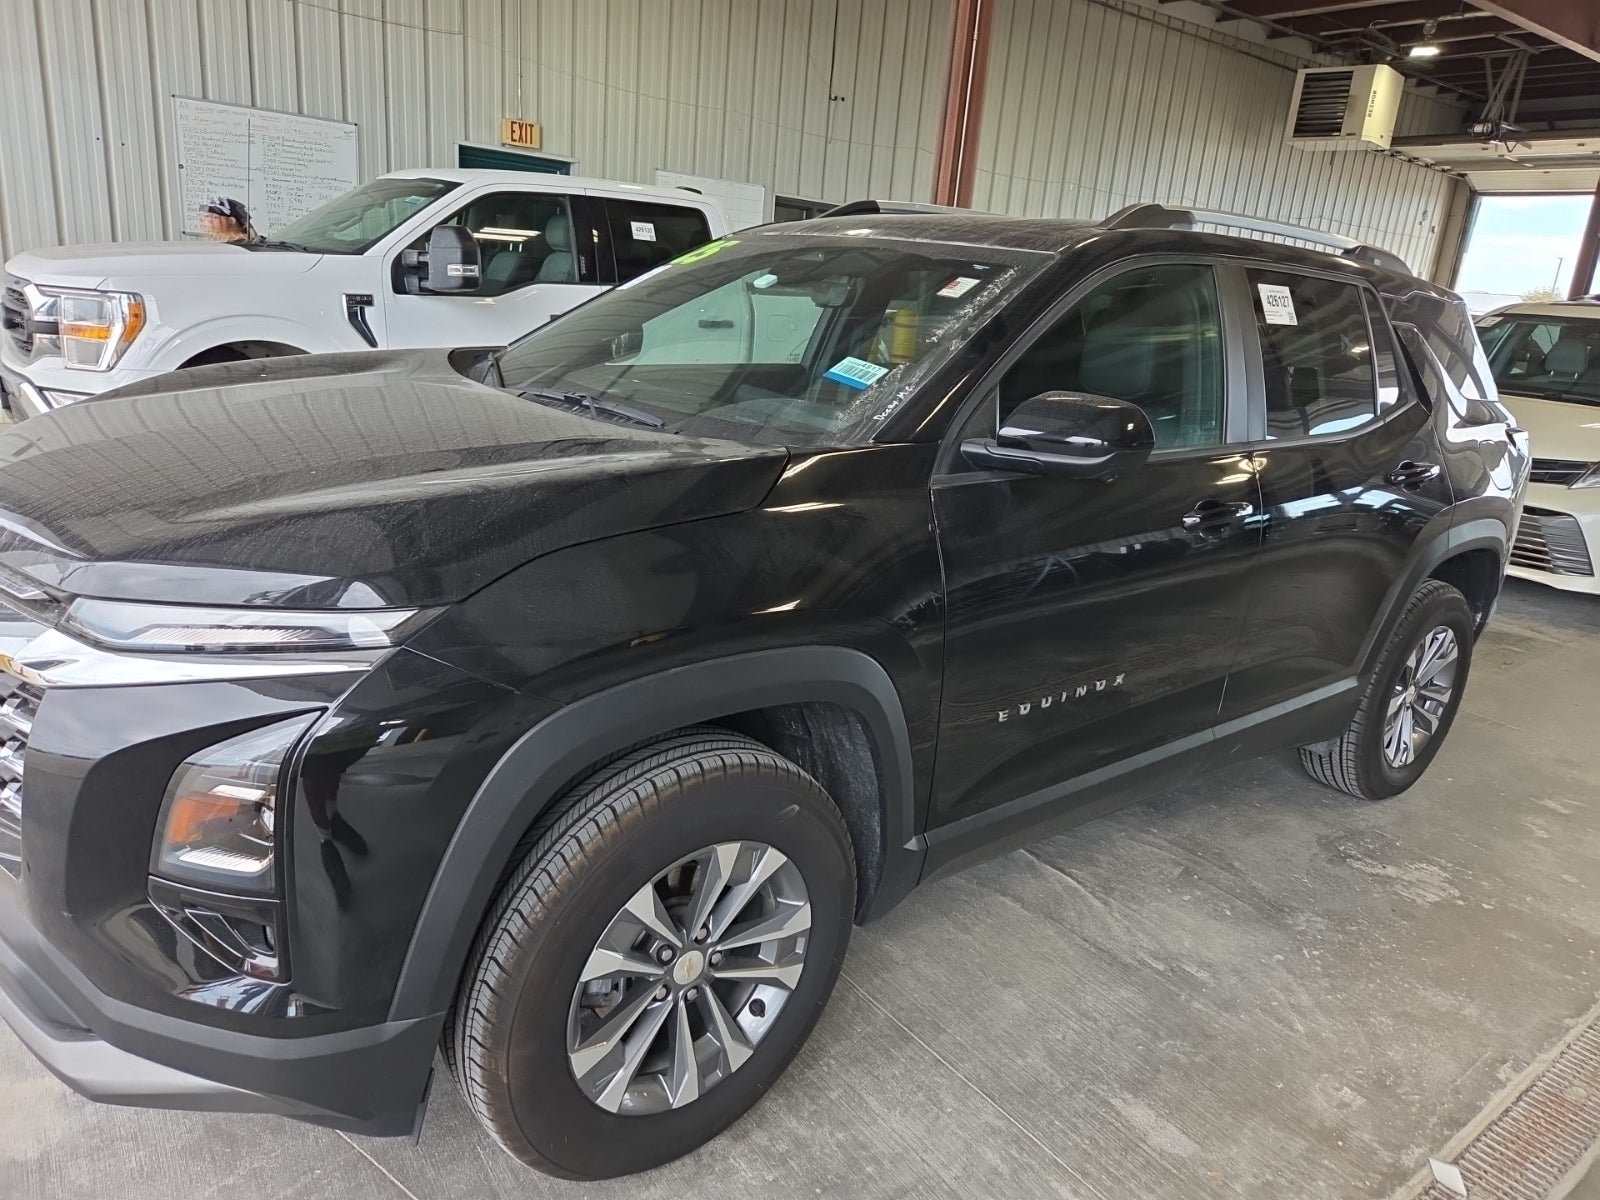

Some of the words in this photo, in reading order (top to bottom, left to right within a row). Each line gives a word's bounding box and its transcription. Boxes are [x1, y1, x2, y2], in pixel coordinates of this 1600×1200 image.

[510, 120, 535, 145] EXIT
[1266, 294, 1290, 308] 426127
[997, 673, 1126, 723] EQUINOX
